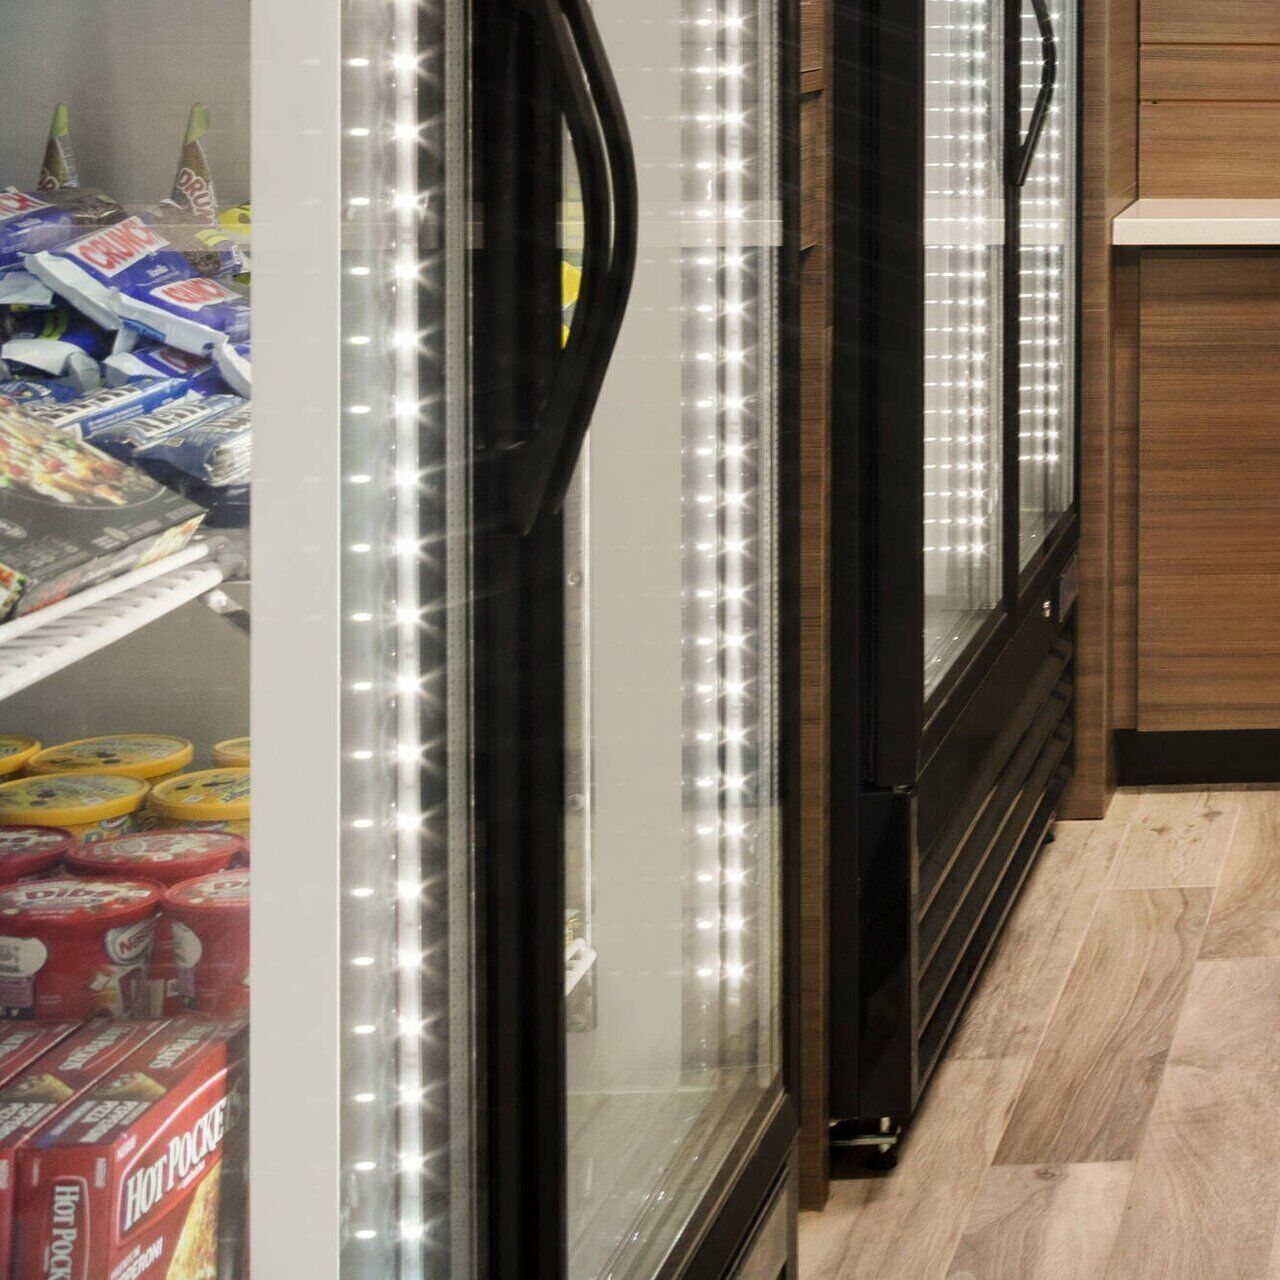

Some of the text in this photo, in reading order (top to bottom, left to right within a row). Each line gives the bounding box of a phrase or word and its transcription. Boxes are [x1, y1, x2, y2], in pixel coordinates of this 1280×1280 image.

[123, 1095, 228, 1231] HOT POCKE
[48, 1184, 80, 1280] HOT POCK
